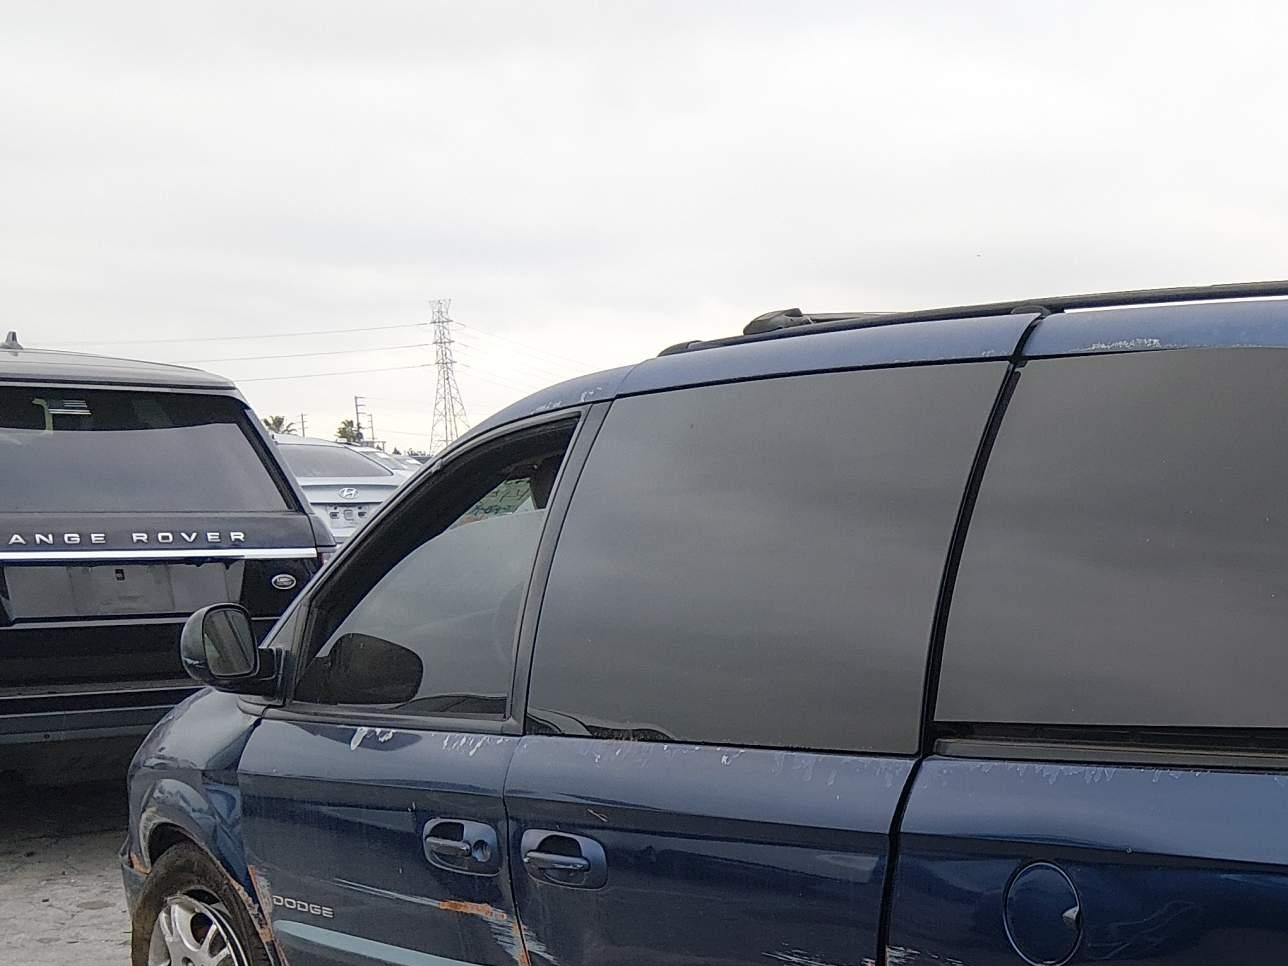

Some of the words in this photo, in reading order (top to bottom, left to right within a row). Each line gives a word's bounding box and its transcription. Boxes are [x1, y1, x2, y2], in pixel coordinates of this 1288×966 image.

[8, 532, 107, 545] ANGE
[132, 531, 246, 544] ROVER
[272, 895, 334, 918] DODGE
